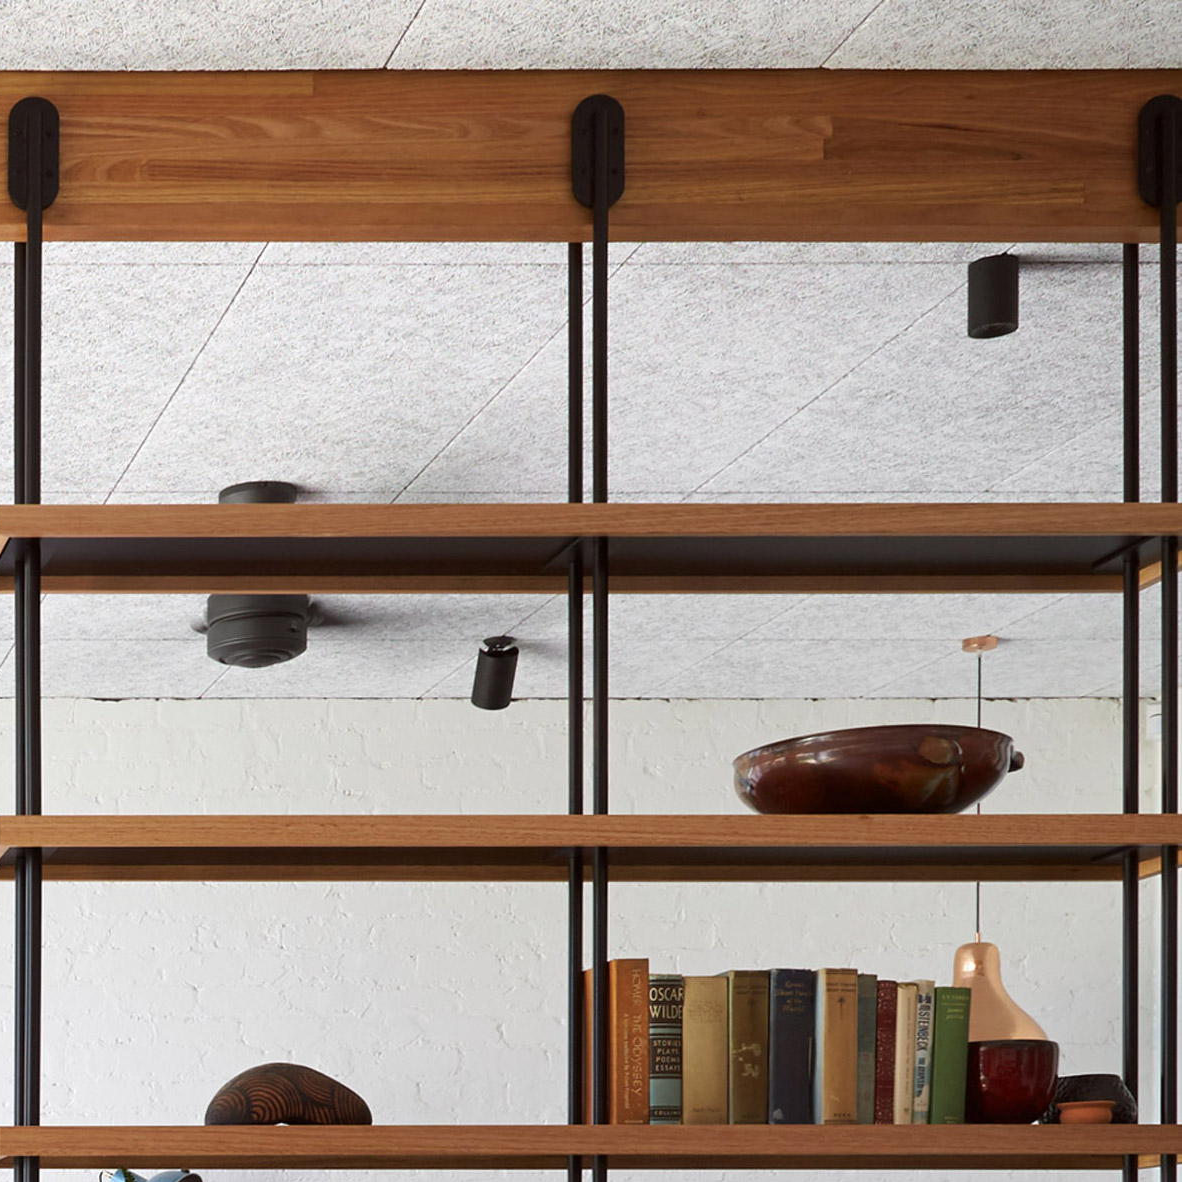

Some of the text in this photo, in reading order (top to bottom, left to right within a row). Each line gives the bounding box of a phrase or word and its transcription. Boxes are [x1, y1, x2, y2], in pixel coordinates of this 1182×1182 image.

[649, 987, 683, 1001] OSCAR
[649, 1005, 683, 1019] WILDE
[631, 968, 643, 1097] HOMER THE ODYSSEY
[917, 1011, 931, 1052] STEINBECK
